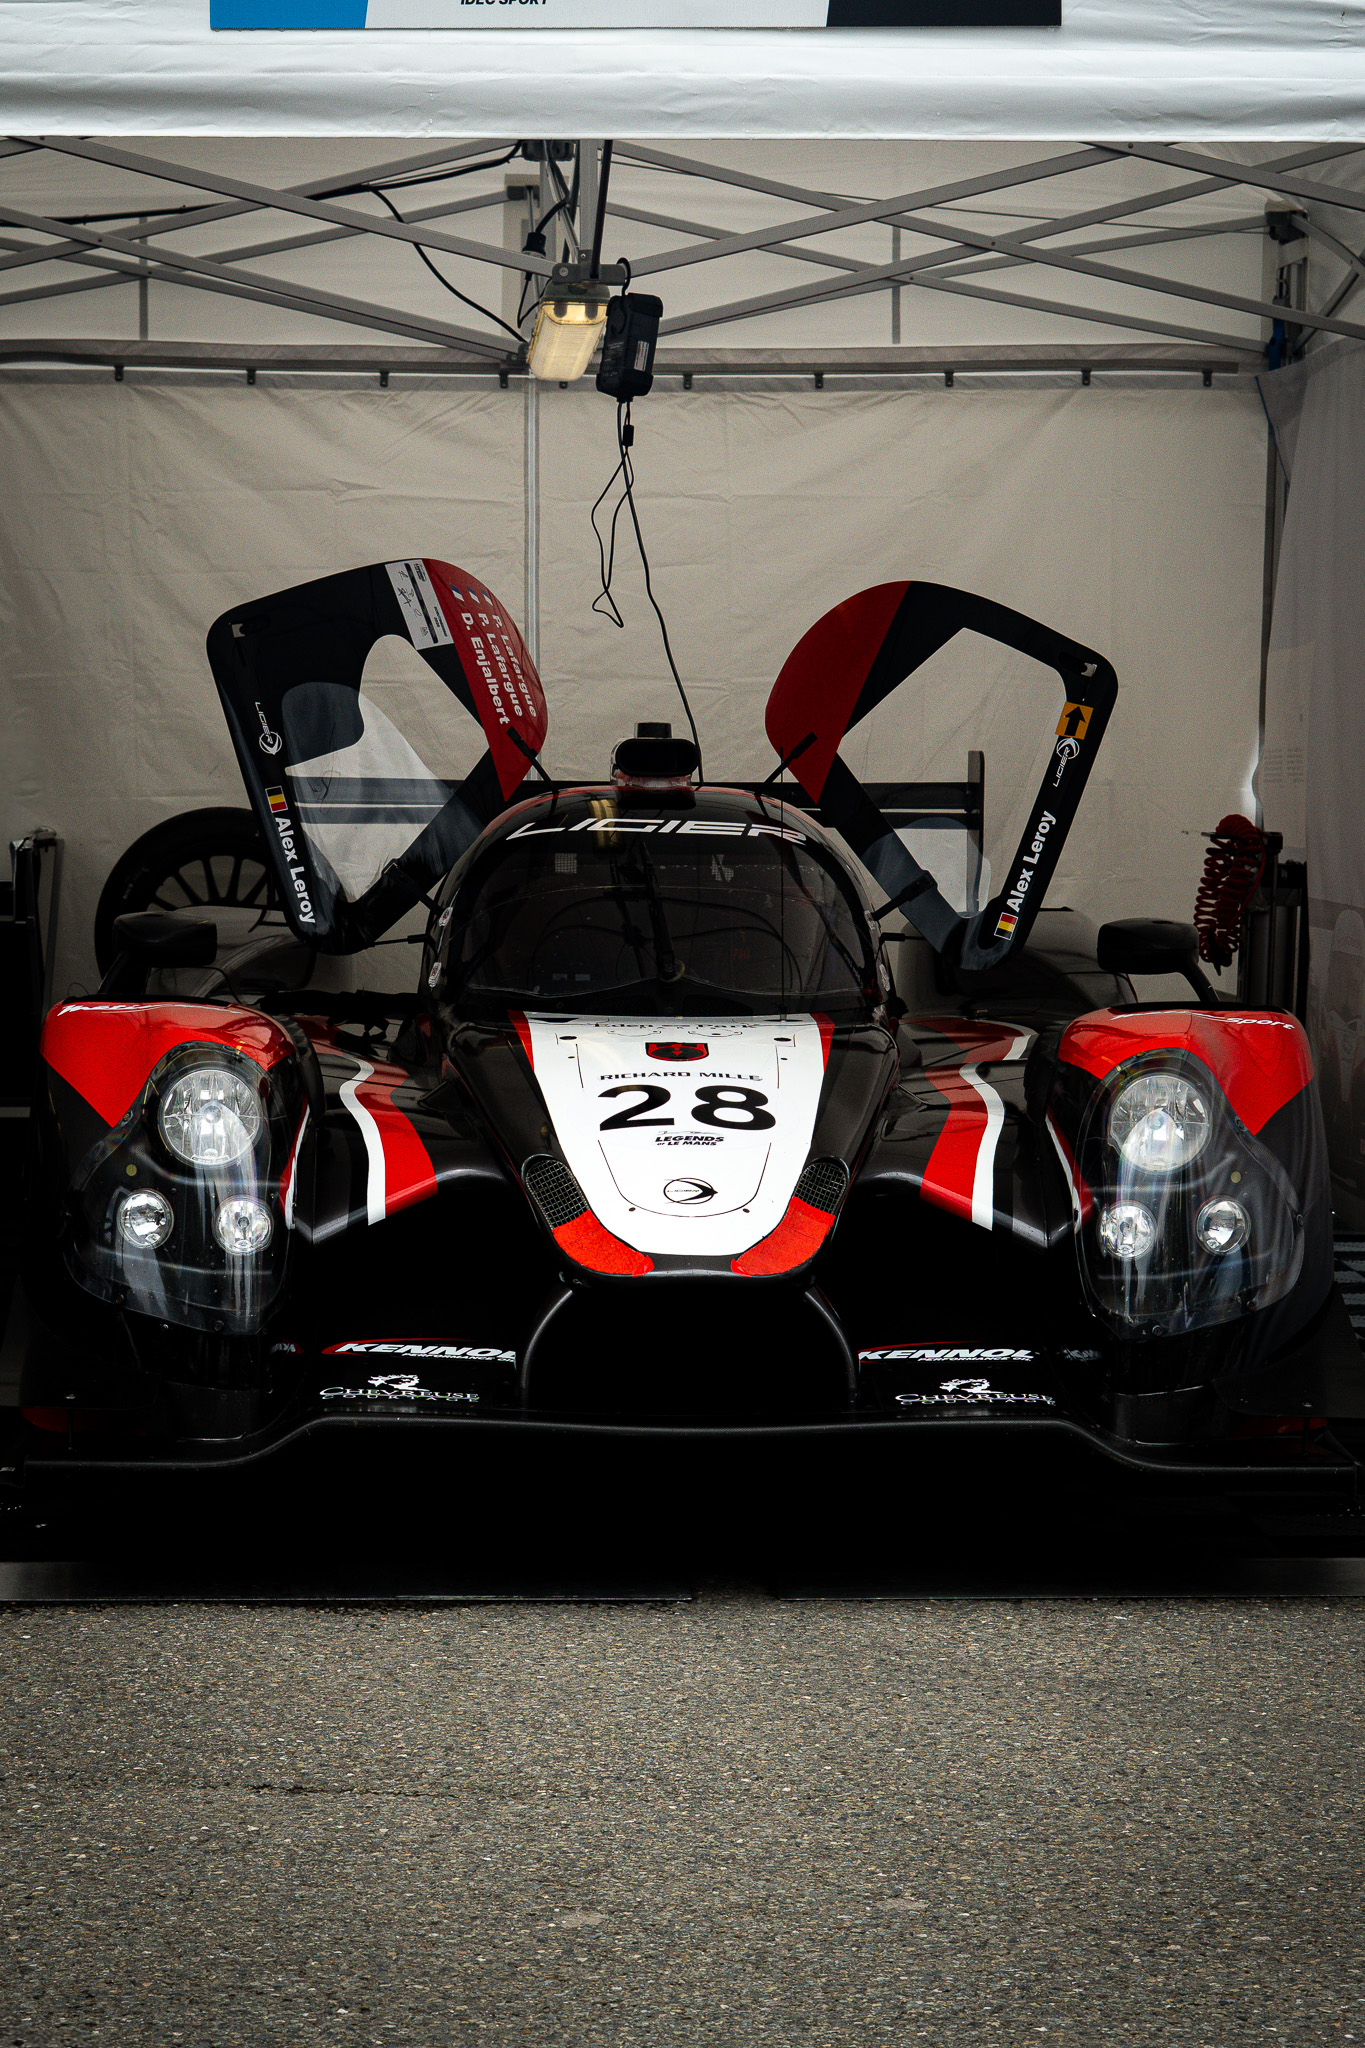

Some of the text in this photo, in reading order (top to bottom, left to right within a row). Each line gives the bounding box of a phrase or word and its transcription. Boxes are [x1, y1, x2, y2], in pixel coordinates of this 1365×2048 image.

[461, 612, 511, 725] D. Enjalbert
[486, 632, 523, 717] Lafargue
[500, 634, 537, 718] Lafargue
[254, 701, 274, 745] LIGIER
[1052, 745, 1071, 788] LIGIER
[505, 817, 807, 846] LIGIER
[275, 817, 316, 924] Alex Leroy
[1006, 810, 1057, 913] Alex Leroy
[600, 1071, 763, 1082] RICHARD MILLE
[597, 1084, 776, 1131] 28
[654, 1135, 725, 1143] LEGENDS
[858, 1348, 1035, 1361] KENNOL
